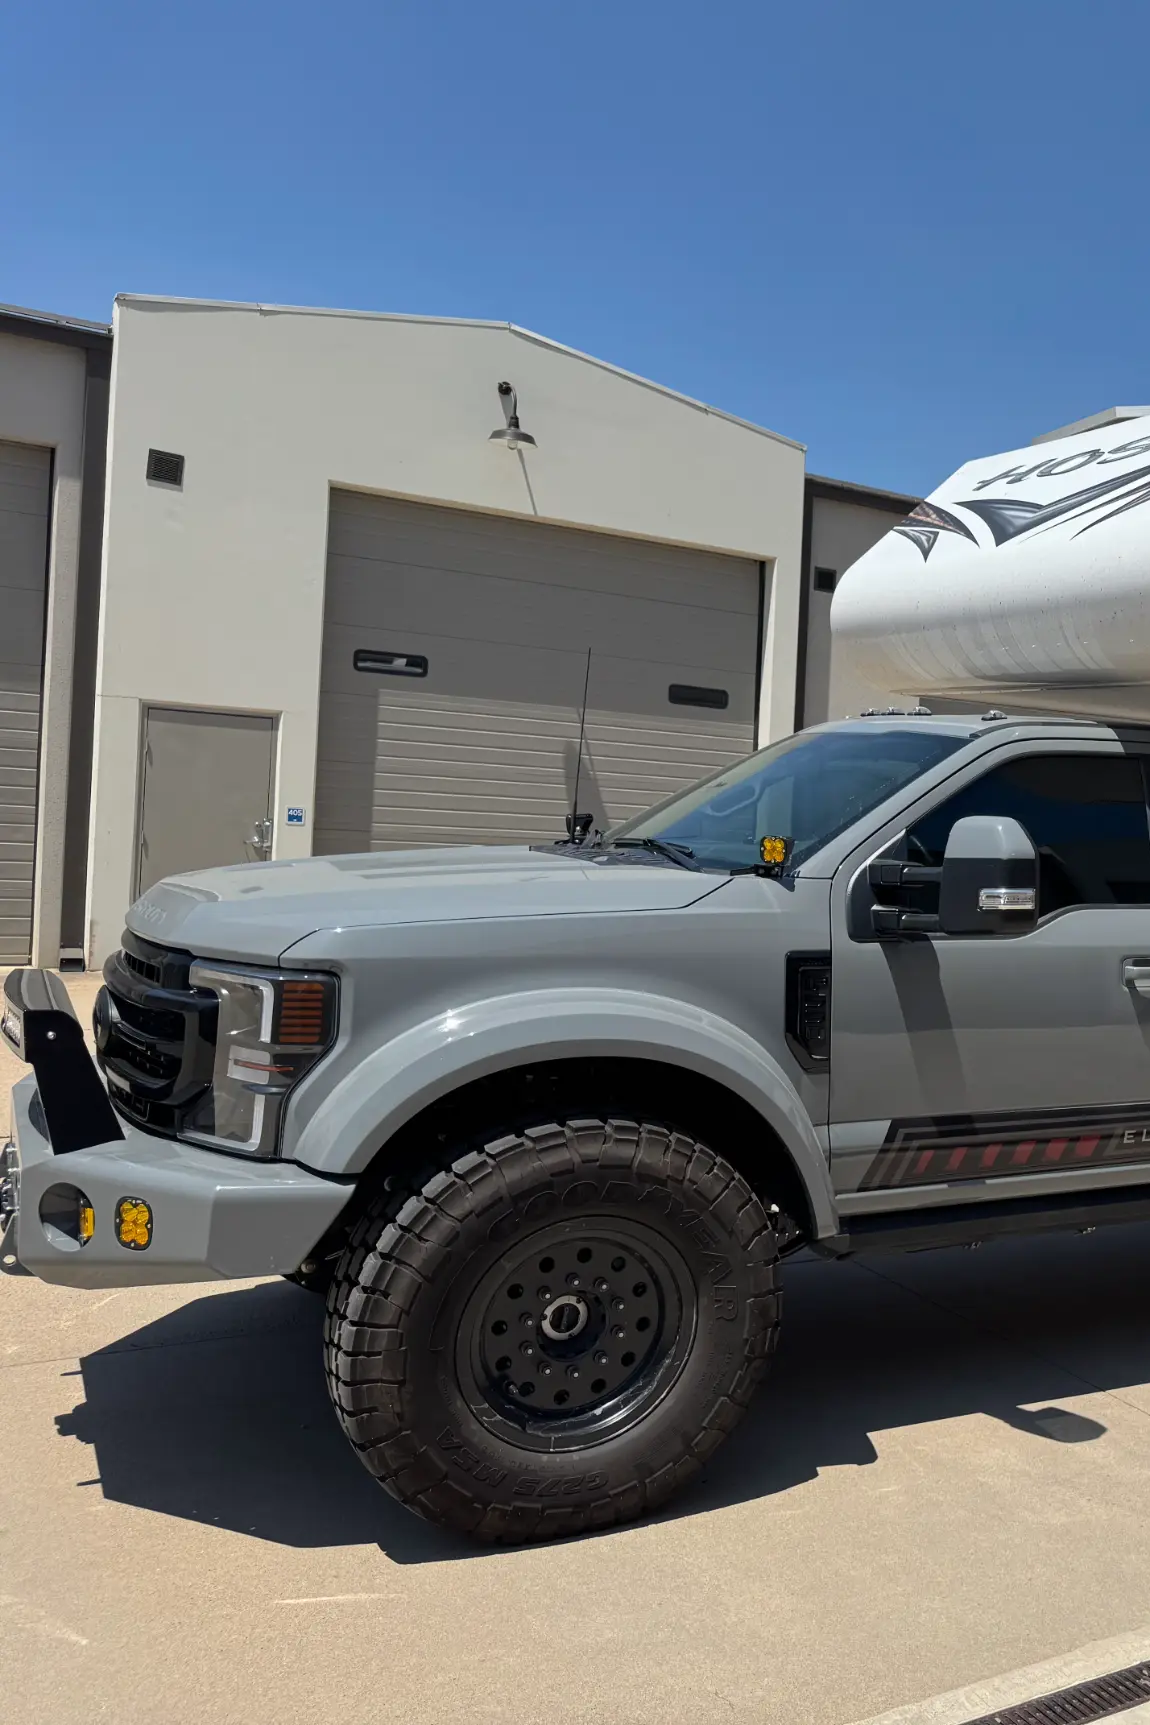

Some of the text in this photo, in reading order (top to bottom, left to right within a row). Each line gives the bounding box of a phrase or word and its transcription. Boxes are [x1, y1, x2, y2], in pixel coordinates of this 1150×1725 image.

[288, 809, 303, 817] 405
[485, 1178, 739, 1322] GOODYEAR
[436, 1425, 509, 1489] MSA
[512, 1468, 611, 1498] G275
